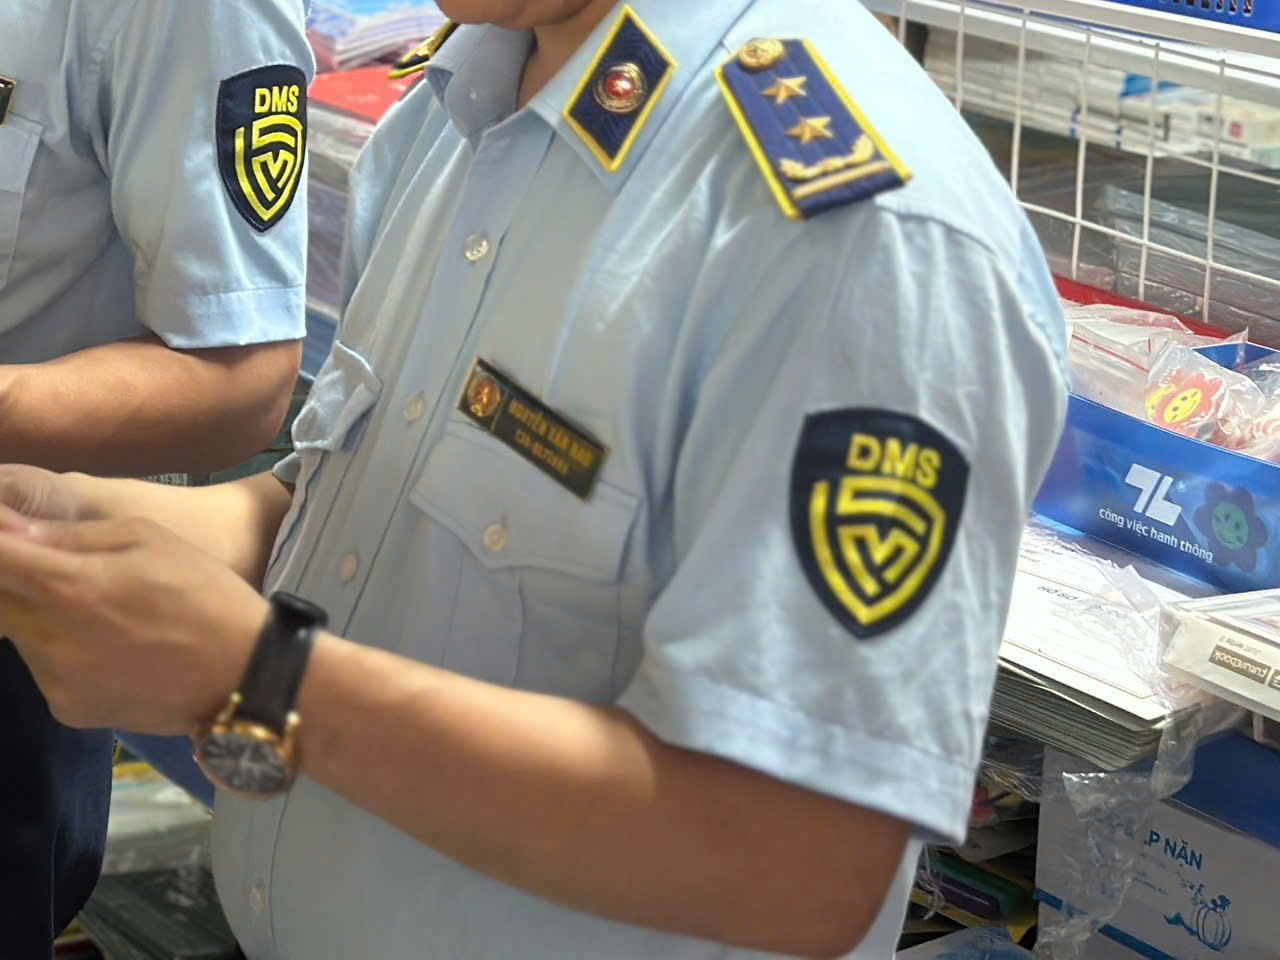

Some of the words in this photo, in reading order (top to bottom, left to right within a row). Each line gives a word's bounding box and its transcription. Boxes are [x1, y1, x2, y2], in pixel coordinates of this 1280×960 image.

[254, 85, 299, 114] DMS
[847, 433, 941, 489] DMS
[1099, 507, 1124, 528] công
[1126, 518, 1149, 537] việc
[1150, 527, 1178, 549] hanh
[1179, 539, 1214, 564] thông
